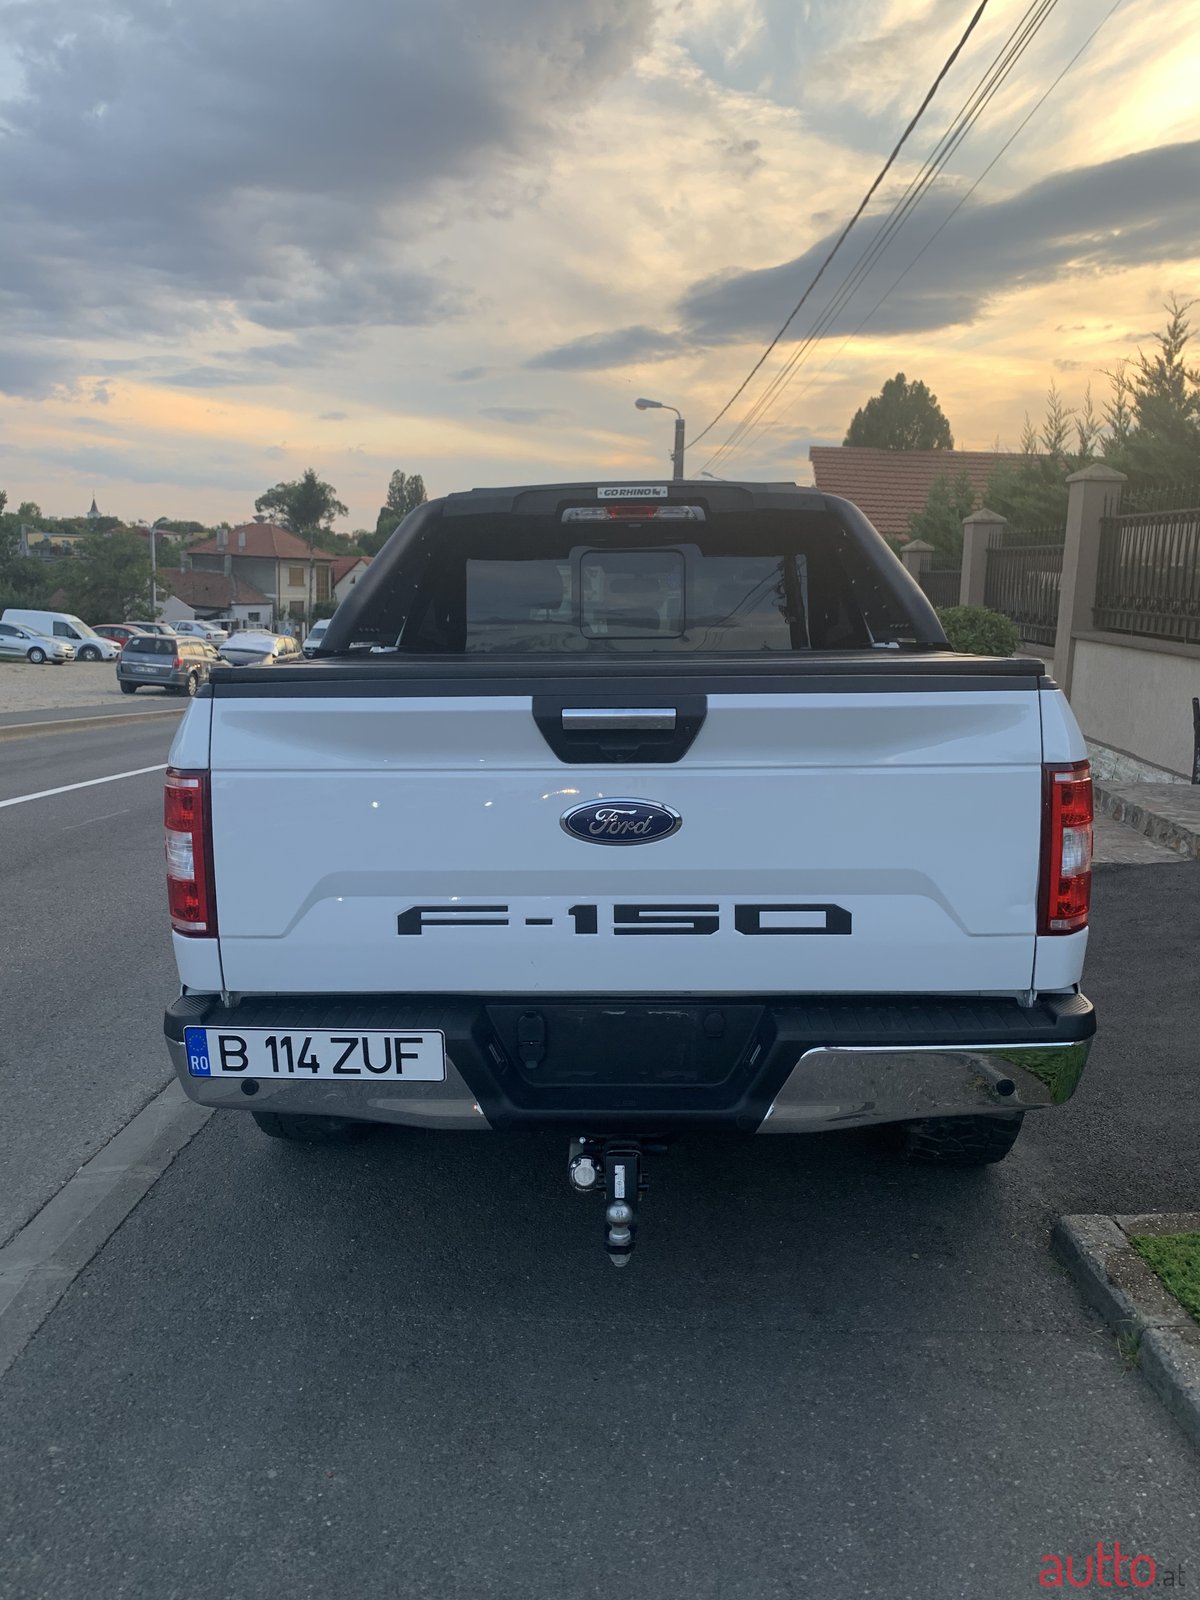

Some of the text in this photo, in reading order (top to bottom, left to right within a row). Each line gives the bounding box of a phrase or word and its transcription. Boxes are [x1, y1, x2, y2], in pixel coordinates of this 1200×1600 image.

[589, 808, 652, 835] Ford
[397, 903, 852, 936] F-150
[190, 1055, 208, 1070] RO
[218, 1035, 423, 1075] B 114 ZUF
